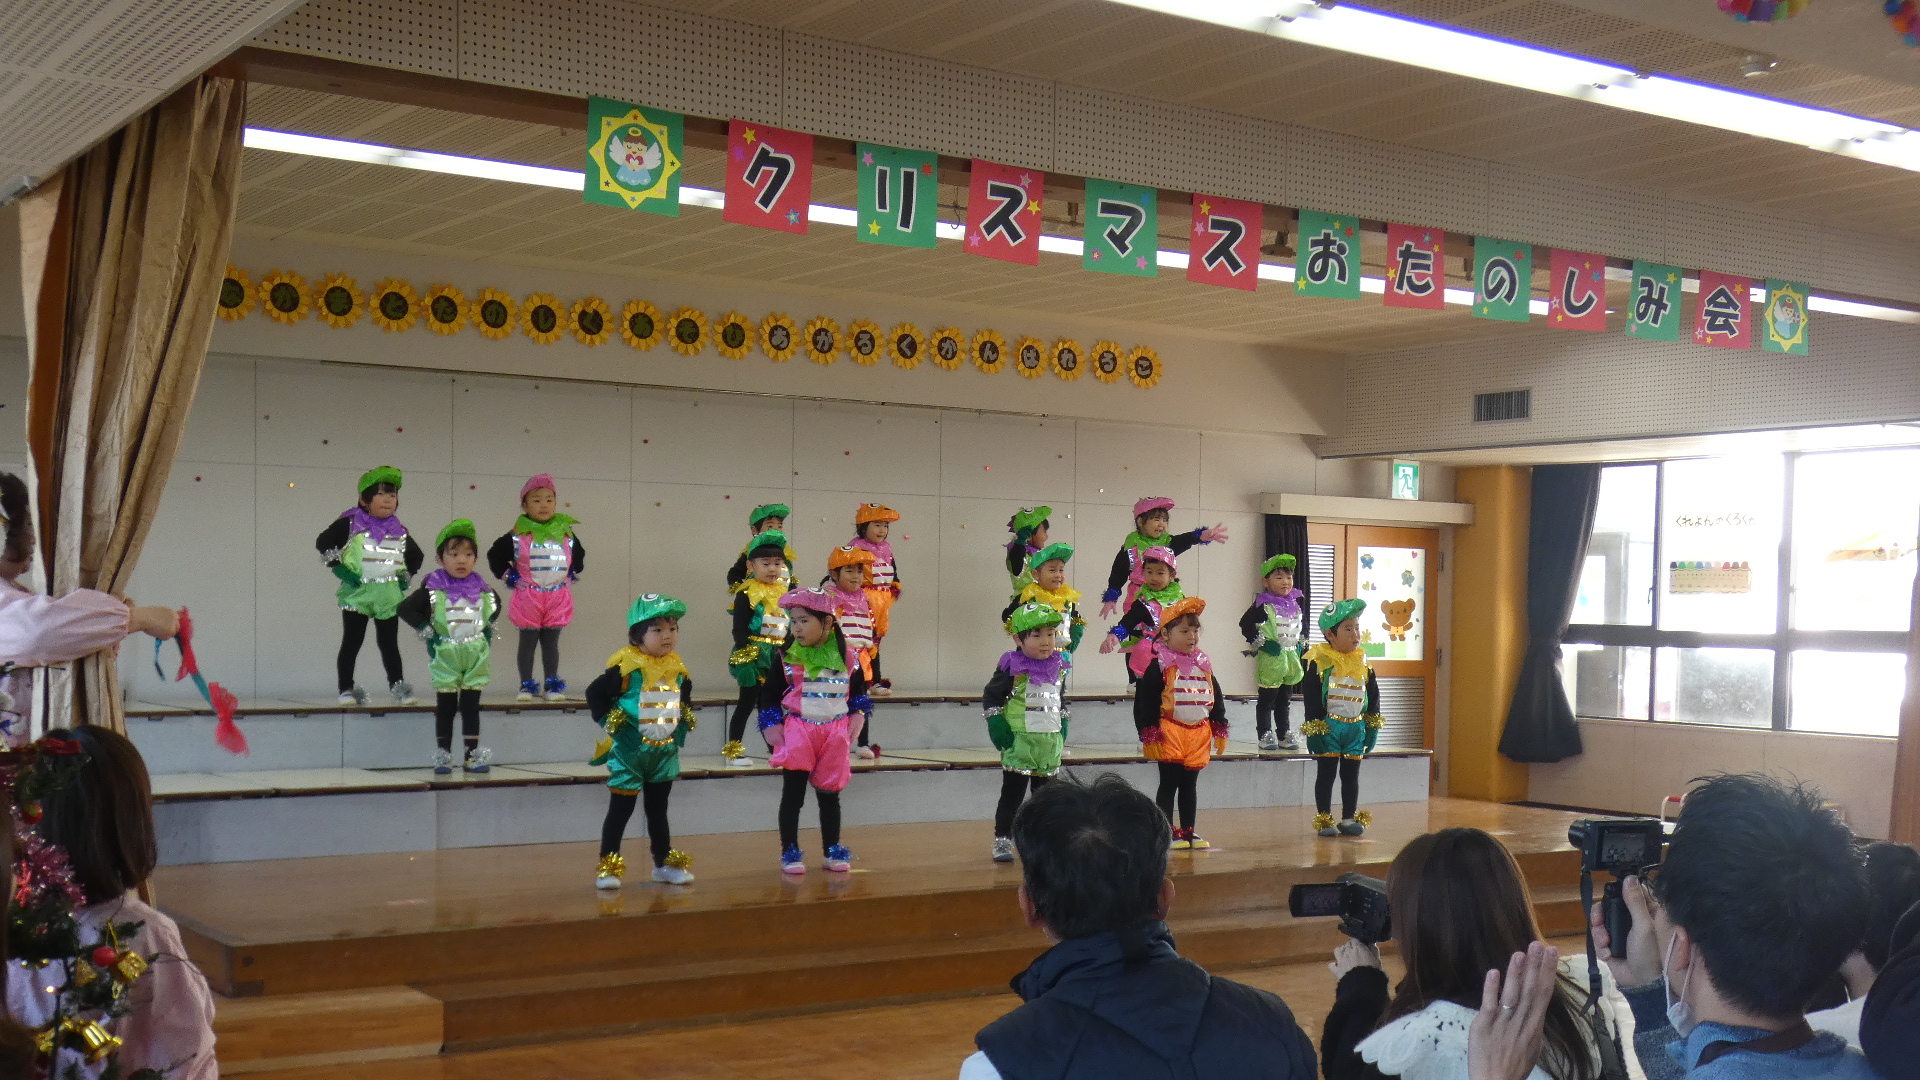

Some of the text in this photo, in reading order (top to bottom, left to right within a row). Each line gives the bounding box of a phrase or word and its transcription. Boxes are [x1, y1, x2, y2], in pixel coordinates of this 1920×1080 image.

[742, 141, 1742, 339] クリスマスおたのしみ会
